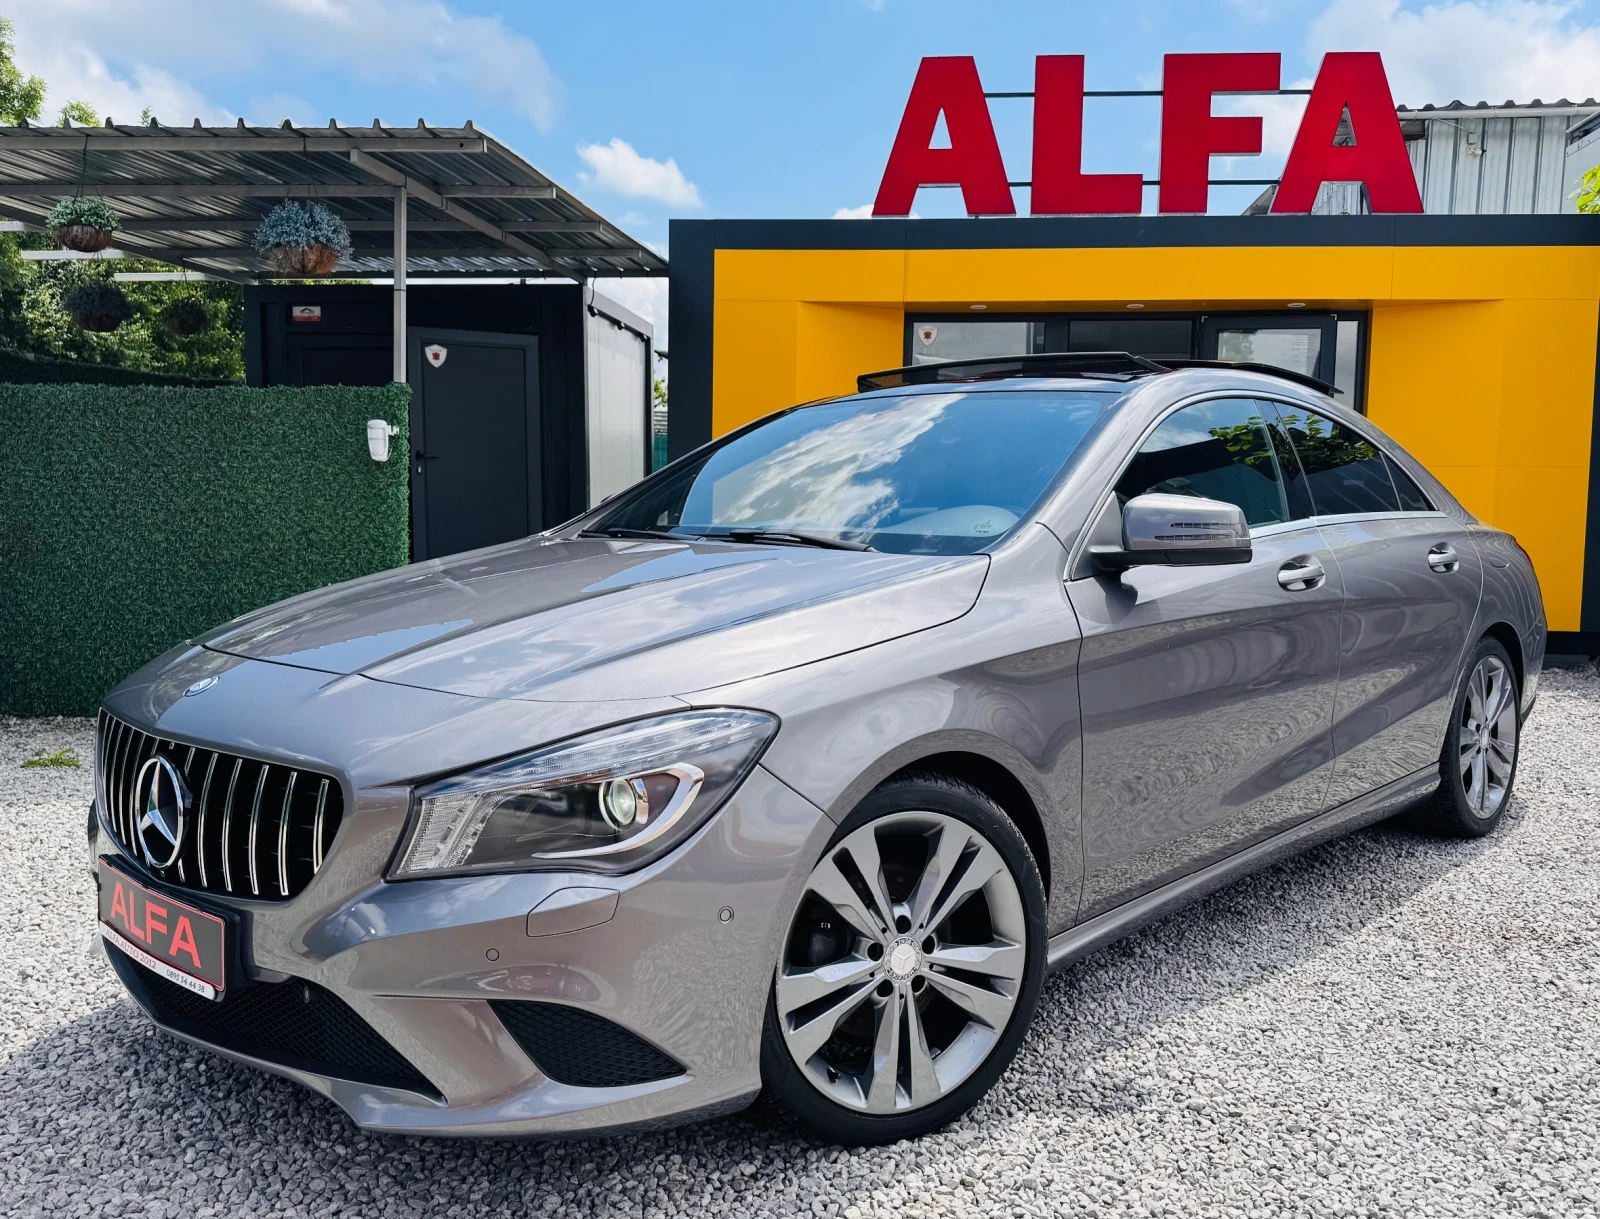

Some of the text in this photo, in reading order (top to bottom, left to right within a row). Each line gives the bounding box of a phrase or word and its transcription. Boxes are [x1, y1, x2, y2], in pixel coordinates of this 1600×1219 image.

[872, 52, 1423, 216] ALFA
[106, 930, 157, 969] ALFA AUTO 2012
[110, 882, 202, 969] ALFA
[166, 969, 180, 981] 0895
[188, 981, 196, 989] 44
[197, 984, 205, 993] 38
